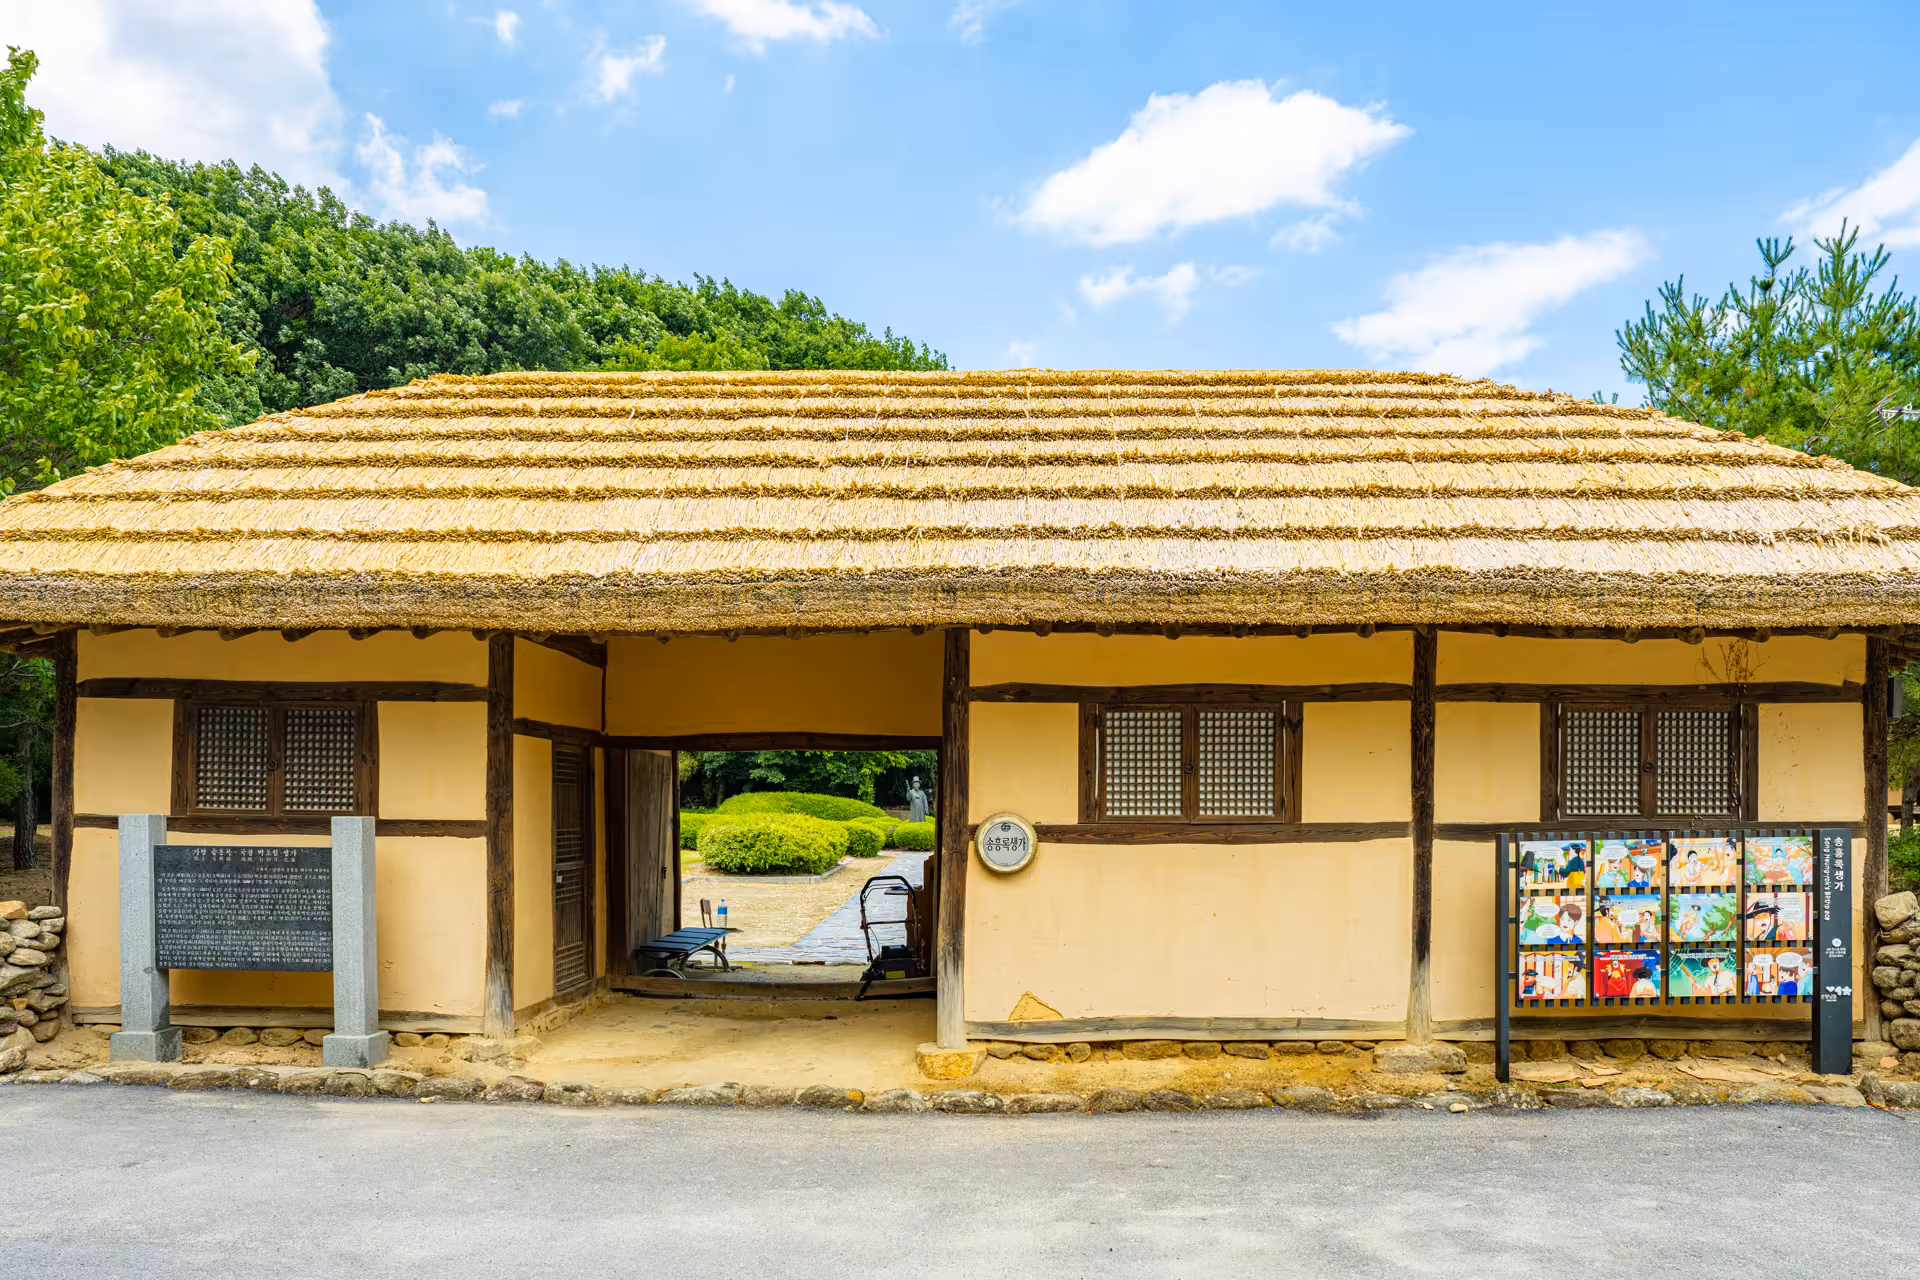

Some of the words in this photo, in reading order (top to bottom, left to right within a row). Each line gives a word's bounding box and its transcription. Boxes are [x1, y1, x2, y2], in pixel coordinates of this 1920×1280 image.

[986, 836, 1026, 851] 송흥록생가
[1823, 837, 1831, 852] Song
[1823, 891, 1831, 921] Birthpace
